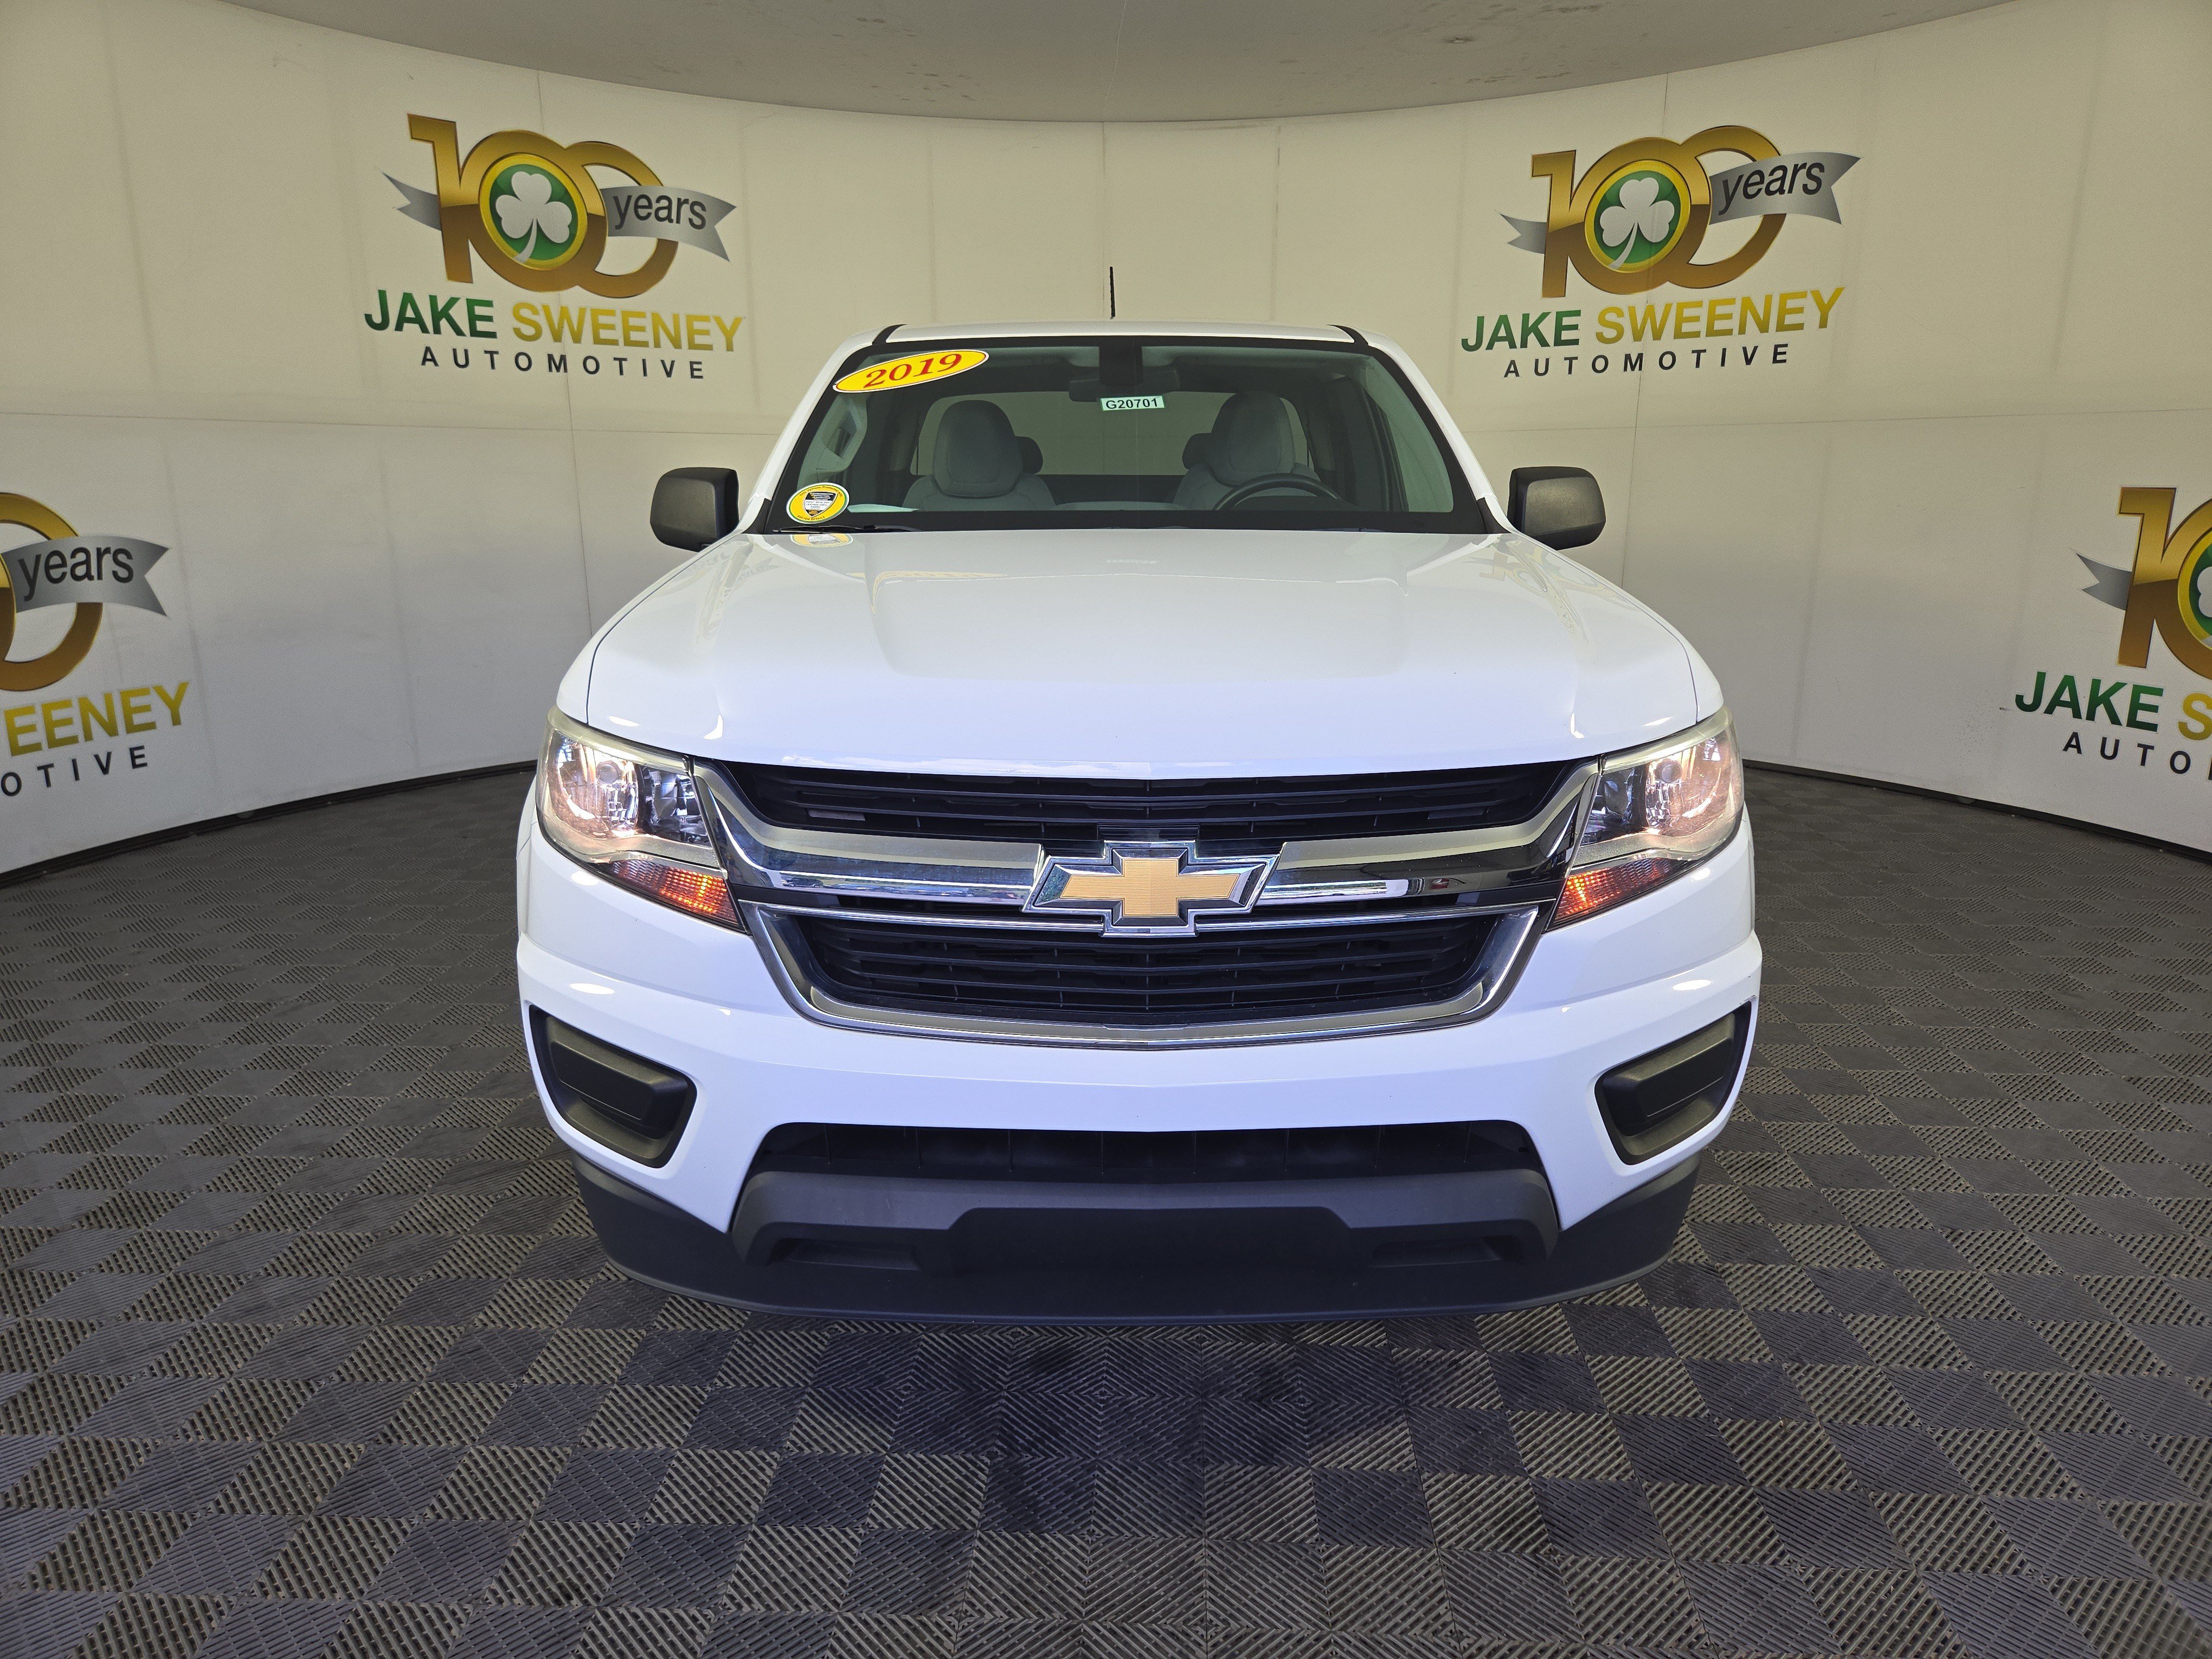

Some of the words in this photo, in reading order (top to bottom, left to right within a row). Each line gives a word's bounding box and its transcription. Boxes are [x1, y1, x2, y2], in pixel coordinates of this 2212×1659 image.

[407, 113, 679, 298] 100
[613, 192, 706, 230] years
[1531, 125, 1787, 298] 100
[1718, 162, 1825, 216] years
[364, 290, 497, 339] JAKE
[512, 302, 743, 351] SWEENEY
[1462, 310, 1581, 352] JAKE
[1596, 287, 1844, 344] SWEENEY
[421, 346, 704, 379] AUTOMOTIVE
[863, 353, 962, 388] 2019
[1504, 343, 1789, 378] AUTOMOTIVE
[1105, 398, 1158, 409] G20701
[18, 545, 134, 602] years
[2015, 671, 2164, 732] JAKE
[1, 745, 147, 796] OTIVE
[2062, 731, 2212, 781] AUTO
